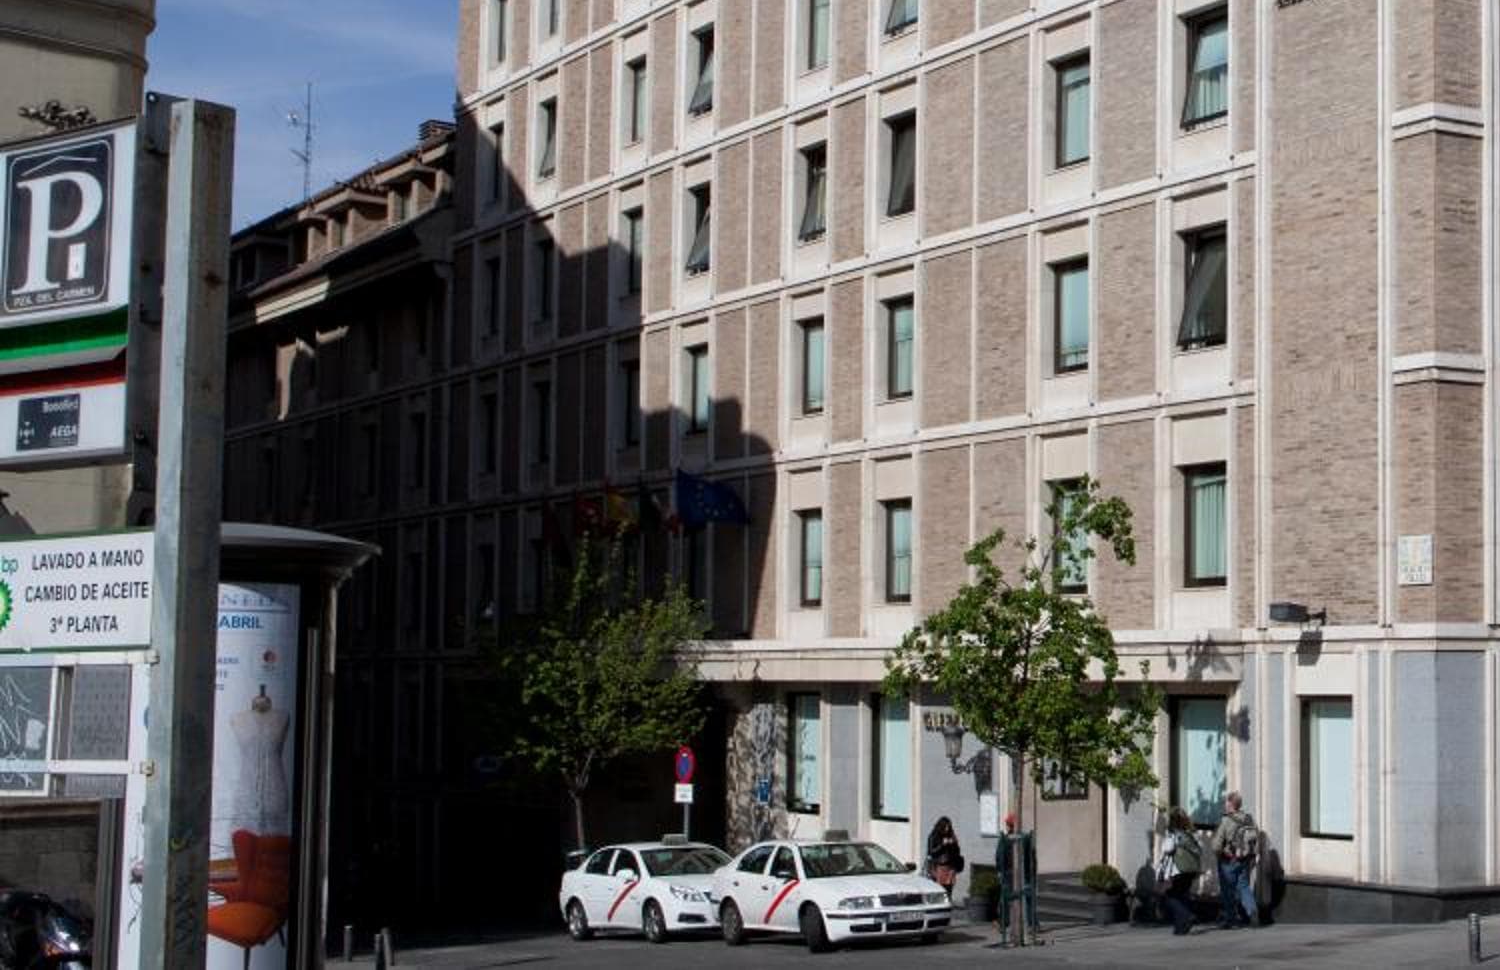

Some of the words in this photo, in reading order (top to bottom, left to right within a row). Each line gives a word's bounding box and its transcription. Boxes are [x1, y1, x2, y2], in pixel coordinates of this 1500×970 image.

[12, 171, 102, 295] P
[32, 552, 85, 571] LAVADO
[88, 551, 98, 567] A
[101, 549, 144, 567] MANO
[25, 583, 77, 603] CAMBIO
[81, 583, 98, 600] DE
[102, 581, 149, 599] ACEITE
[66, 615, 118, 633] PLANTA
[219, 615, 264, 629] ABRIL
